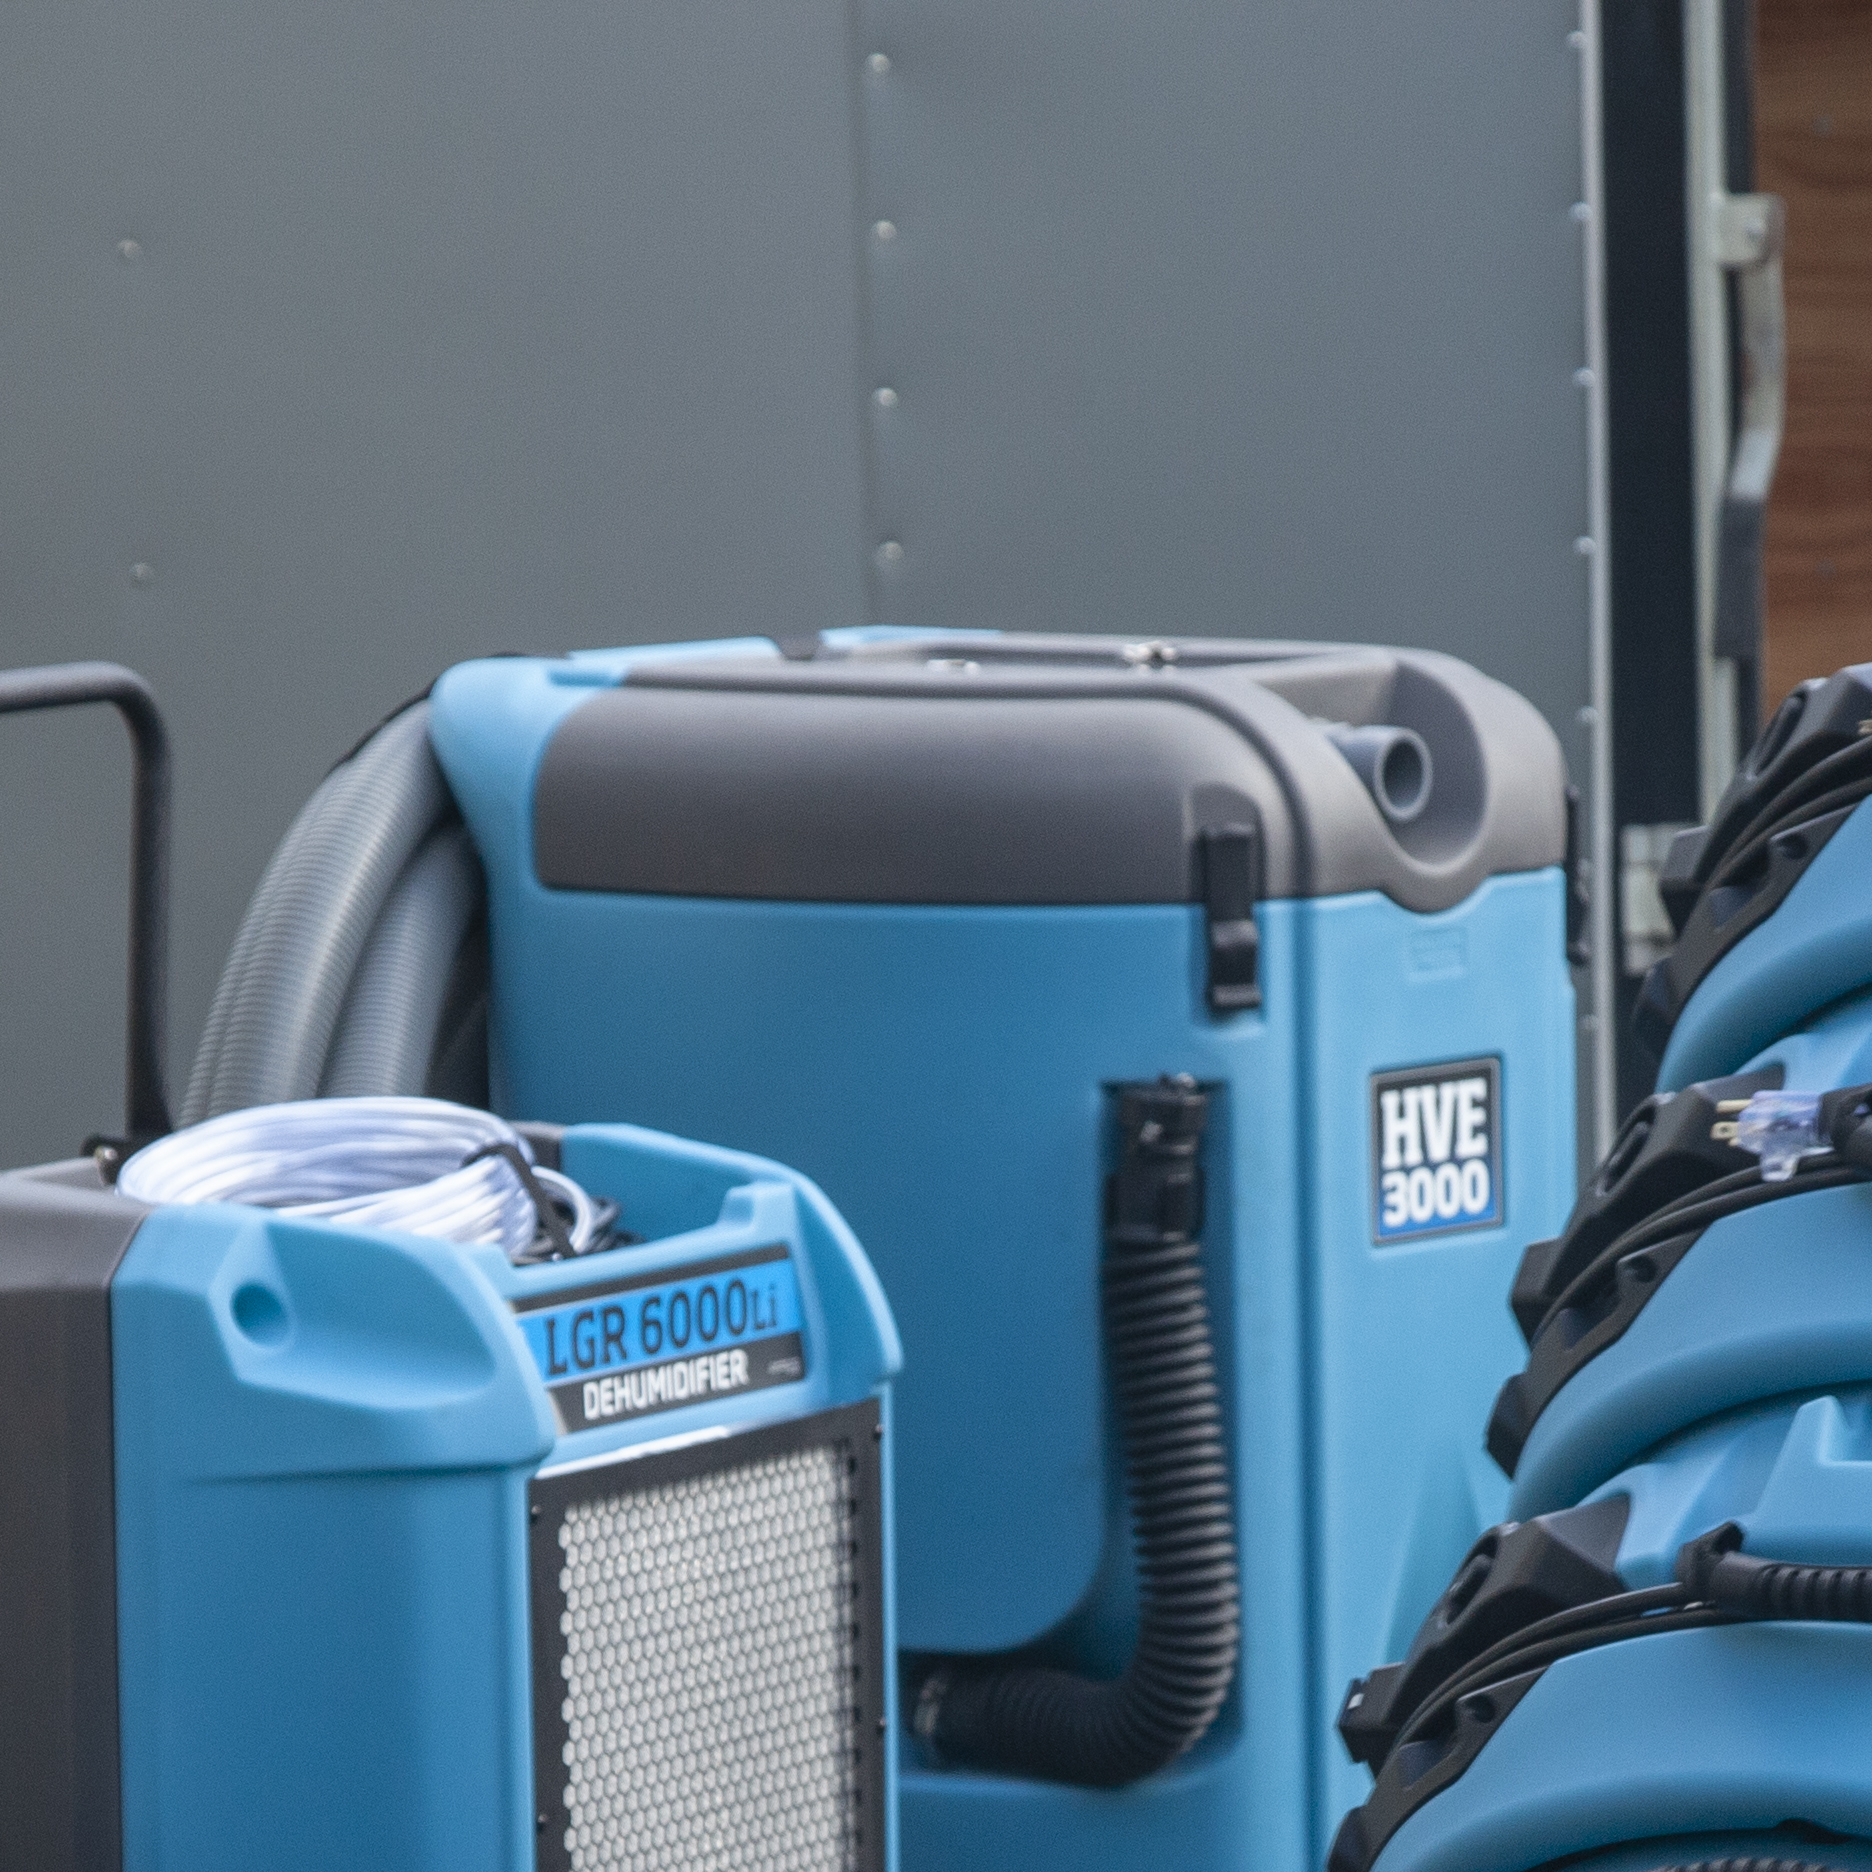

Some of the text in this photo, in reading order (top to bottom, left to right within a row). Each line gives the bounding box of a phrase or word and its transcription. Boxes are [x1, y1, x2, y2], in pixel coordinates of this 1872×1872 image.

[1380, 1077, 1488, 1169] HVE
[1381, 1158, 1490, 1227] 3000
[546, 1306, 627, 1376] LGR
[582, 1349, 750, 1420] DEHUMIDIFIER
